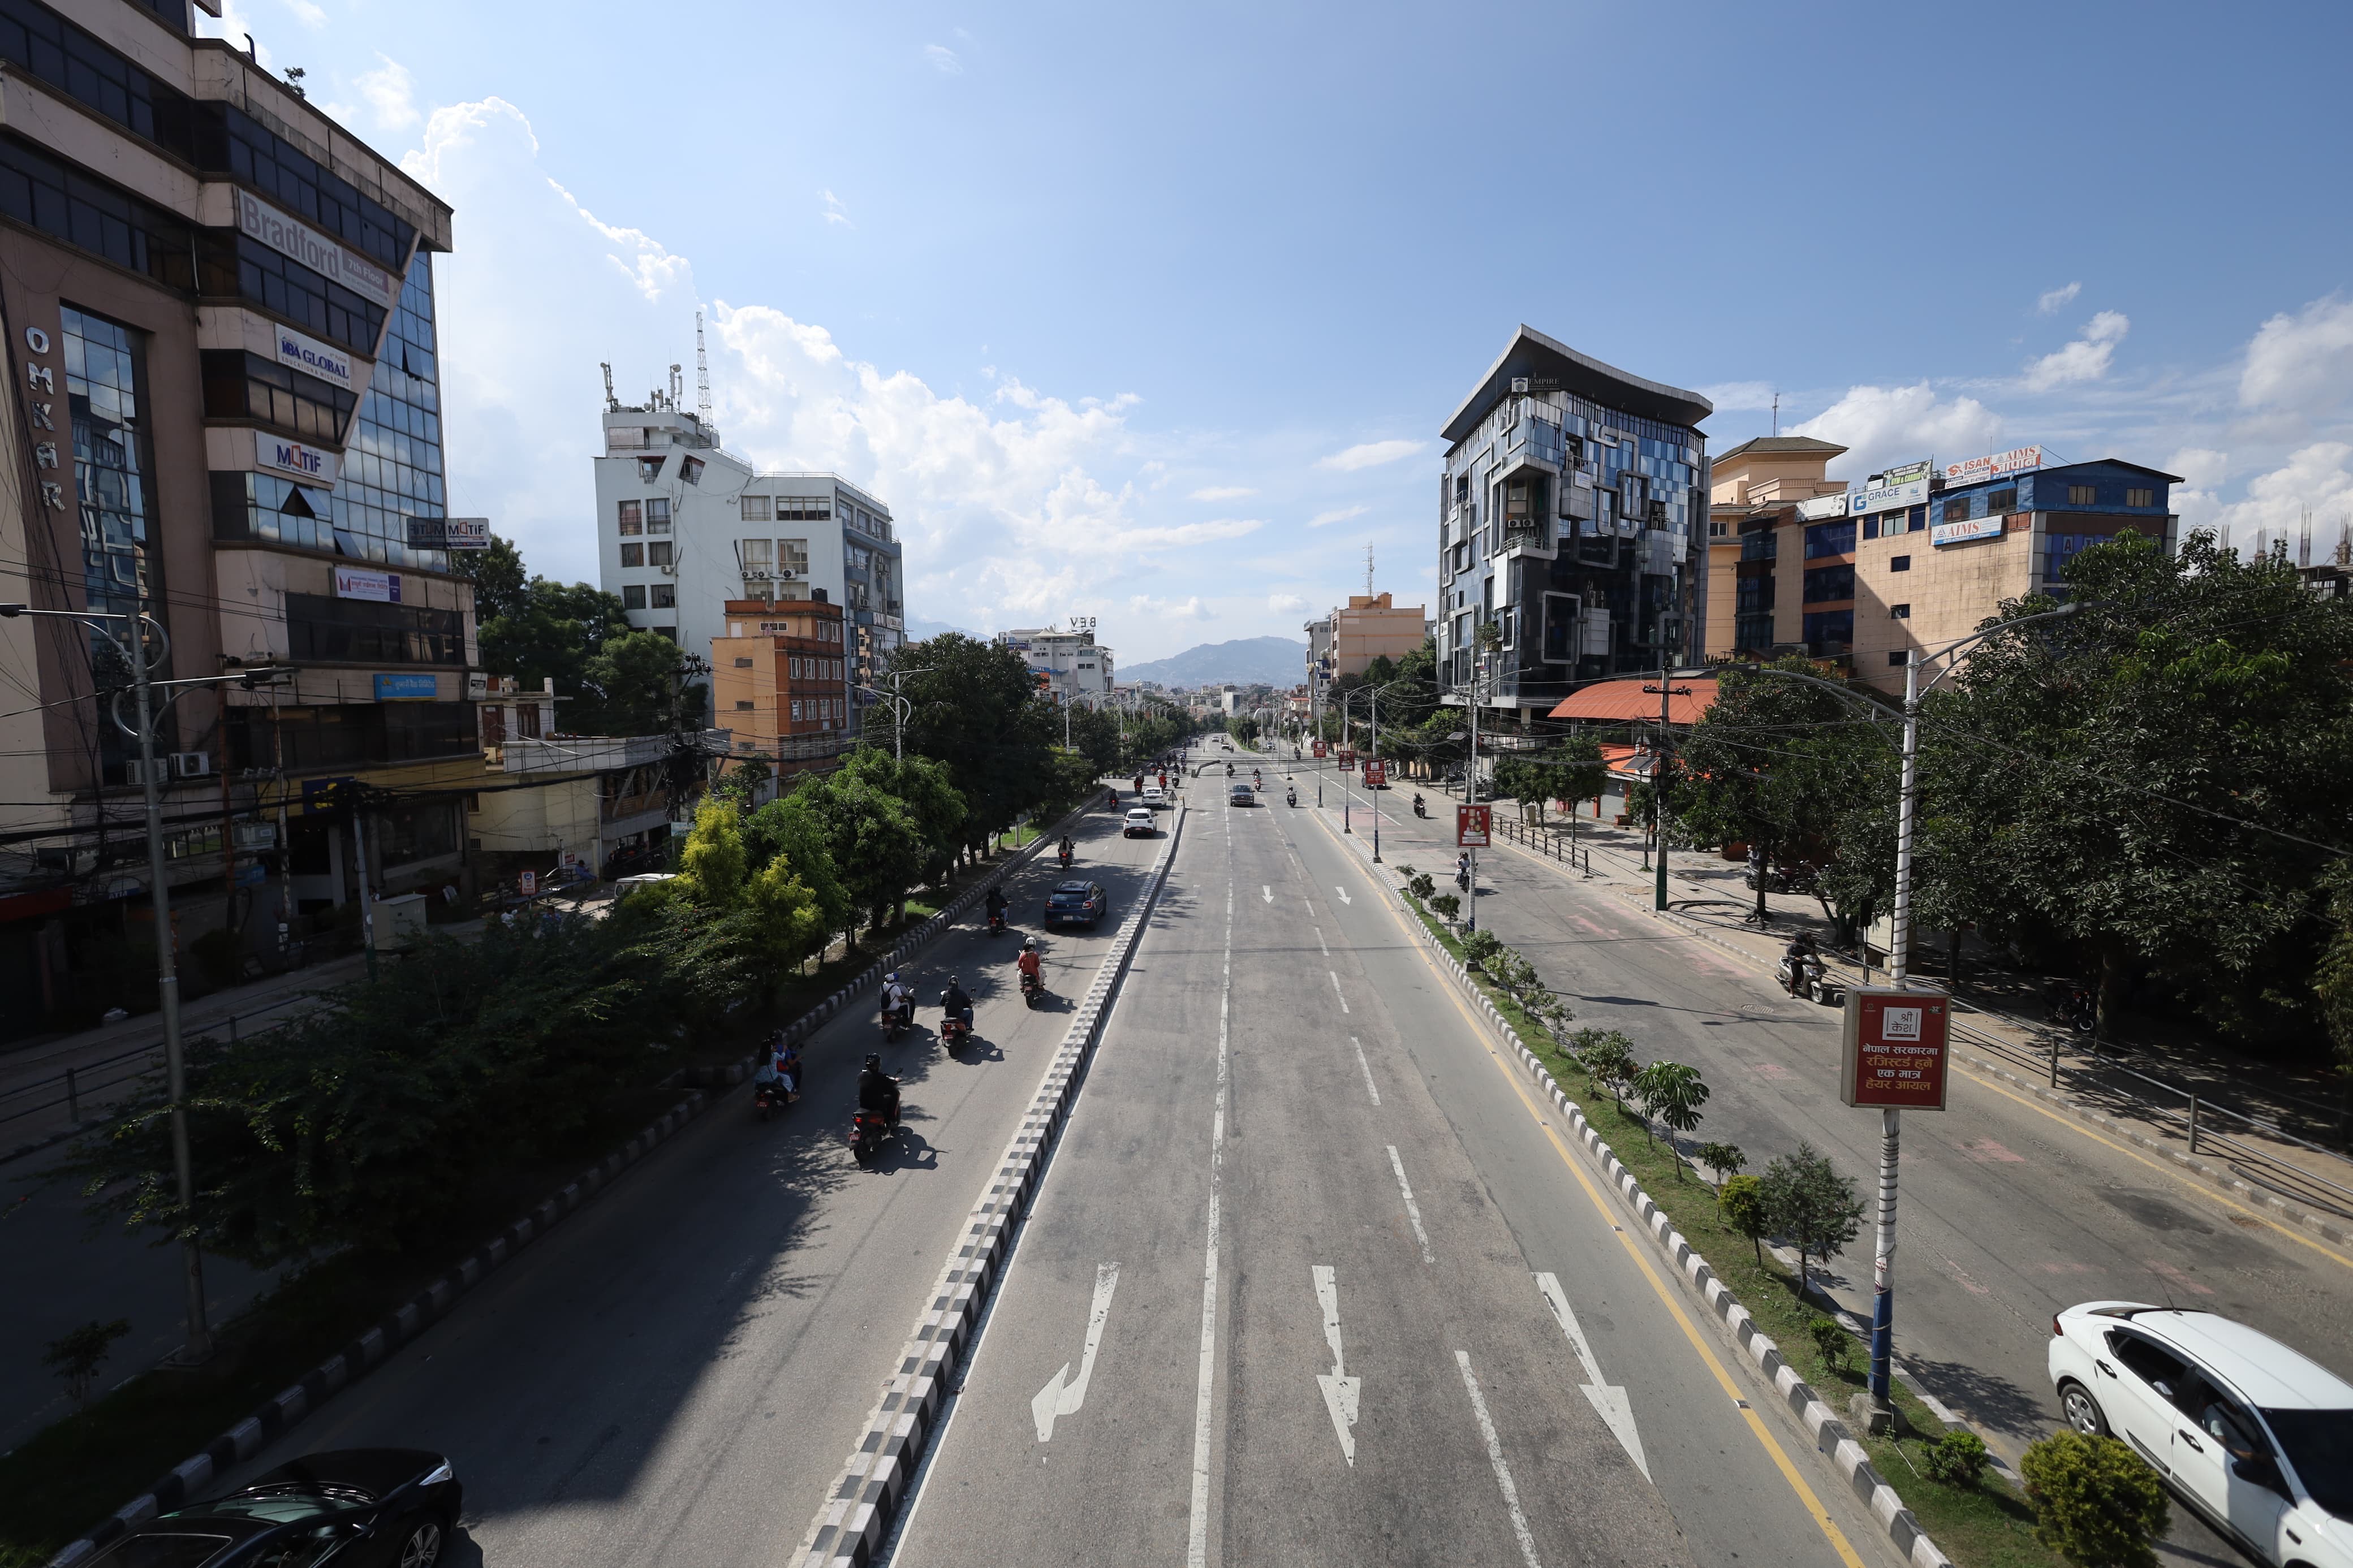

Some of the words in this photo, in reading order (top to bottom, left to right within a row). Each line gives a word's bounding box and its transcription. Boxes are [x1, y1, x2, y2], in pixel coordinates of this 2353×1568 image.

[243, 194, 339, 278] Bradford
[348, 258, 362, 275] 7th
[364, 266, 383, 286] Floor
[303, 349, 349, 379] GLOBAL
[26, 326, 66, 512] OMKAR
[2006, 446, 2036, 460] AIMS
[1965, 457, 1990, 470] ISAN
[1964, 466, 1990, 475] EDUCATION
[1891, 477, 1901, 485] GYM
[1868, 487, 1900, 500] GRACE
[1947, 521, 1979, 537] AIMS
[1901, 1011, 1914, 1022] श्री
[1891, 1021, 1913, 1033] केश
[1863, 1043, 1890, 1053] नेपाल
[1893, 1046, 1938, 1055] सरकारमा
[1867, 1055, 1911, 1067] रजिस्टर्ड
[1914, 1057, 1933, 1070] हुने
[1877, 1069, 1895, 1078] एक
[1899, 1070, 1921, 1079] मात्र
[1865, 1077, 1892, 1089] हेयर
[1895, 1081, 1932, 1090] आयल
